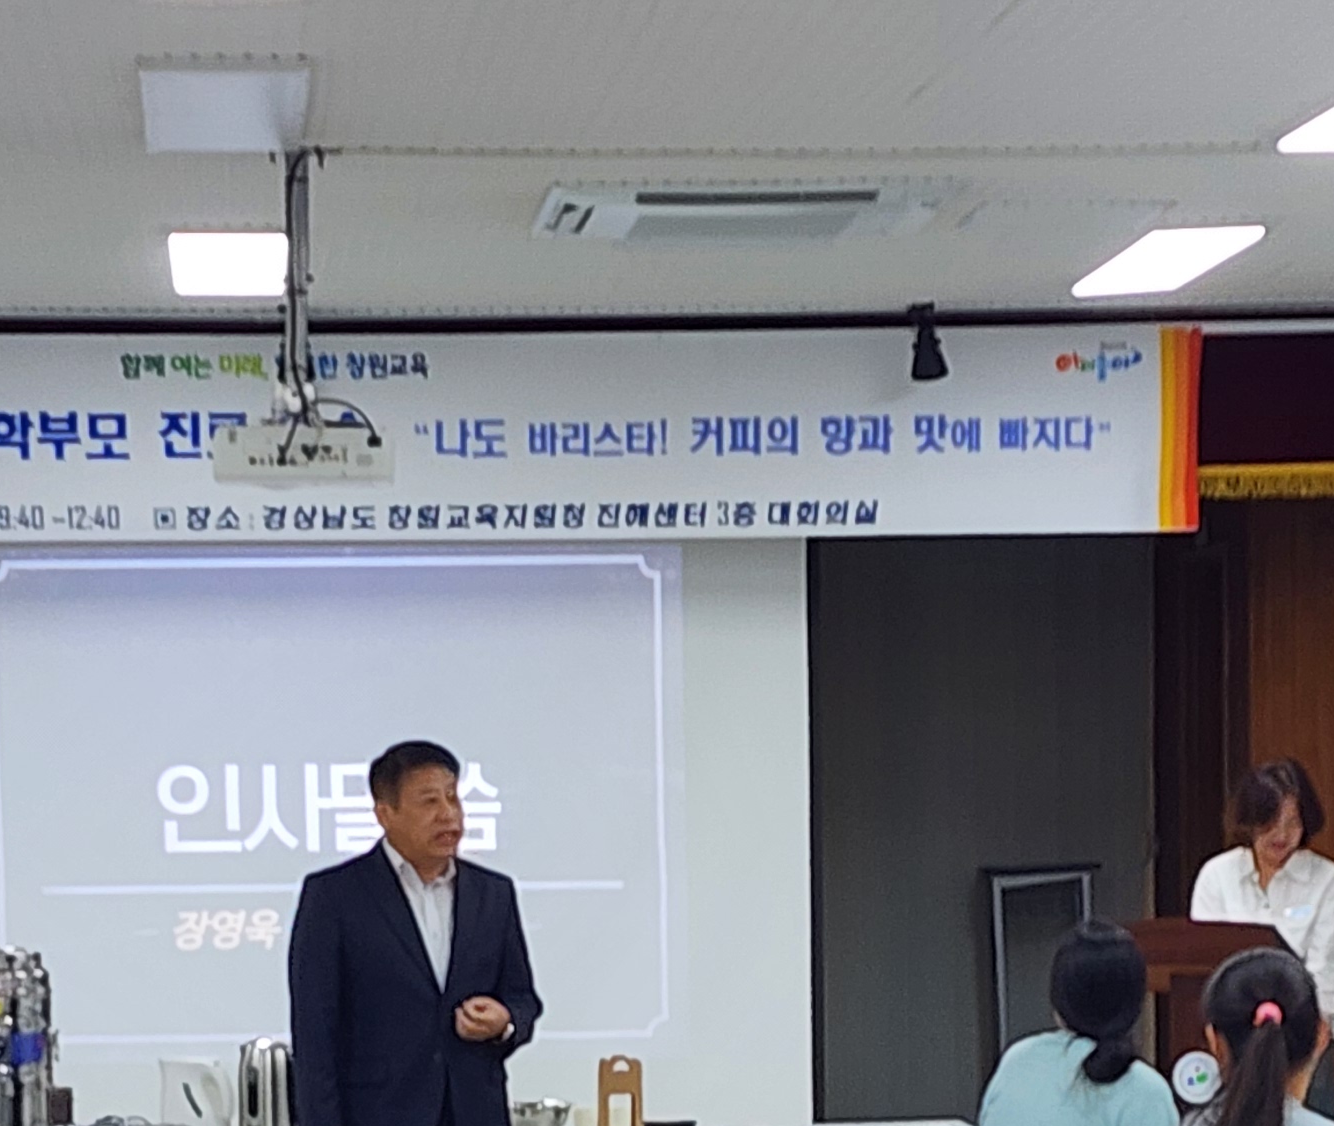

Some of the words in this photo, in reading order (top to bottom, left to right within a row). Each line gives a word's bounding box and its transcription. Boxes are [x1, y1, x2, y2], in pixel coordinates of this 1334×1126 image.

[120, 353, 166, 380] 함께
[171, 353, 213, 379] 여는
[346, 352, 430, 379] 창원교육
[527, 418, 667, 457] 바리스타!
[691, 415, 799, 457] 커피의
[820, 414, 893, 456] 향과
[913, 414, 982, 454] 맛에
[262, 504, 376, 531] 경상남도
[388, 503, 585, 531] 창원교육지원청
[597, 502, 707, 529] 진해센터
[717, 501, 756, 527] 3층
[767, 500, 879, 526] 대회의실
[173, 908, 283, 951] 장영욱
